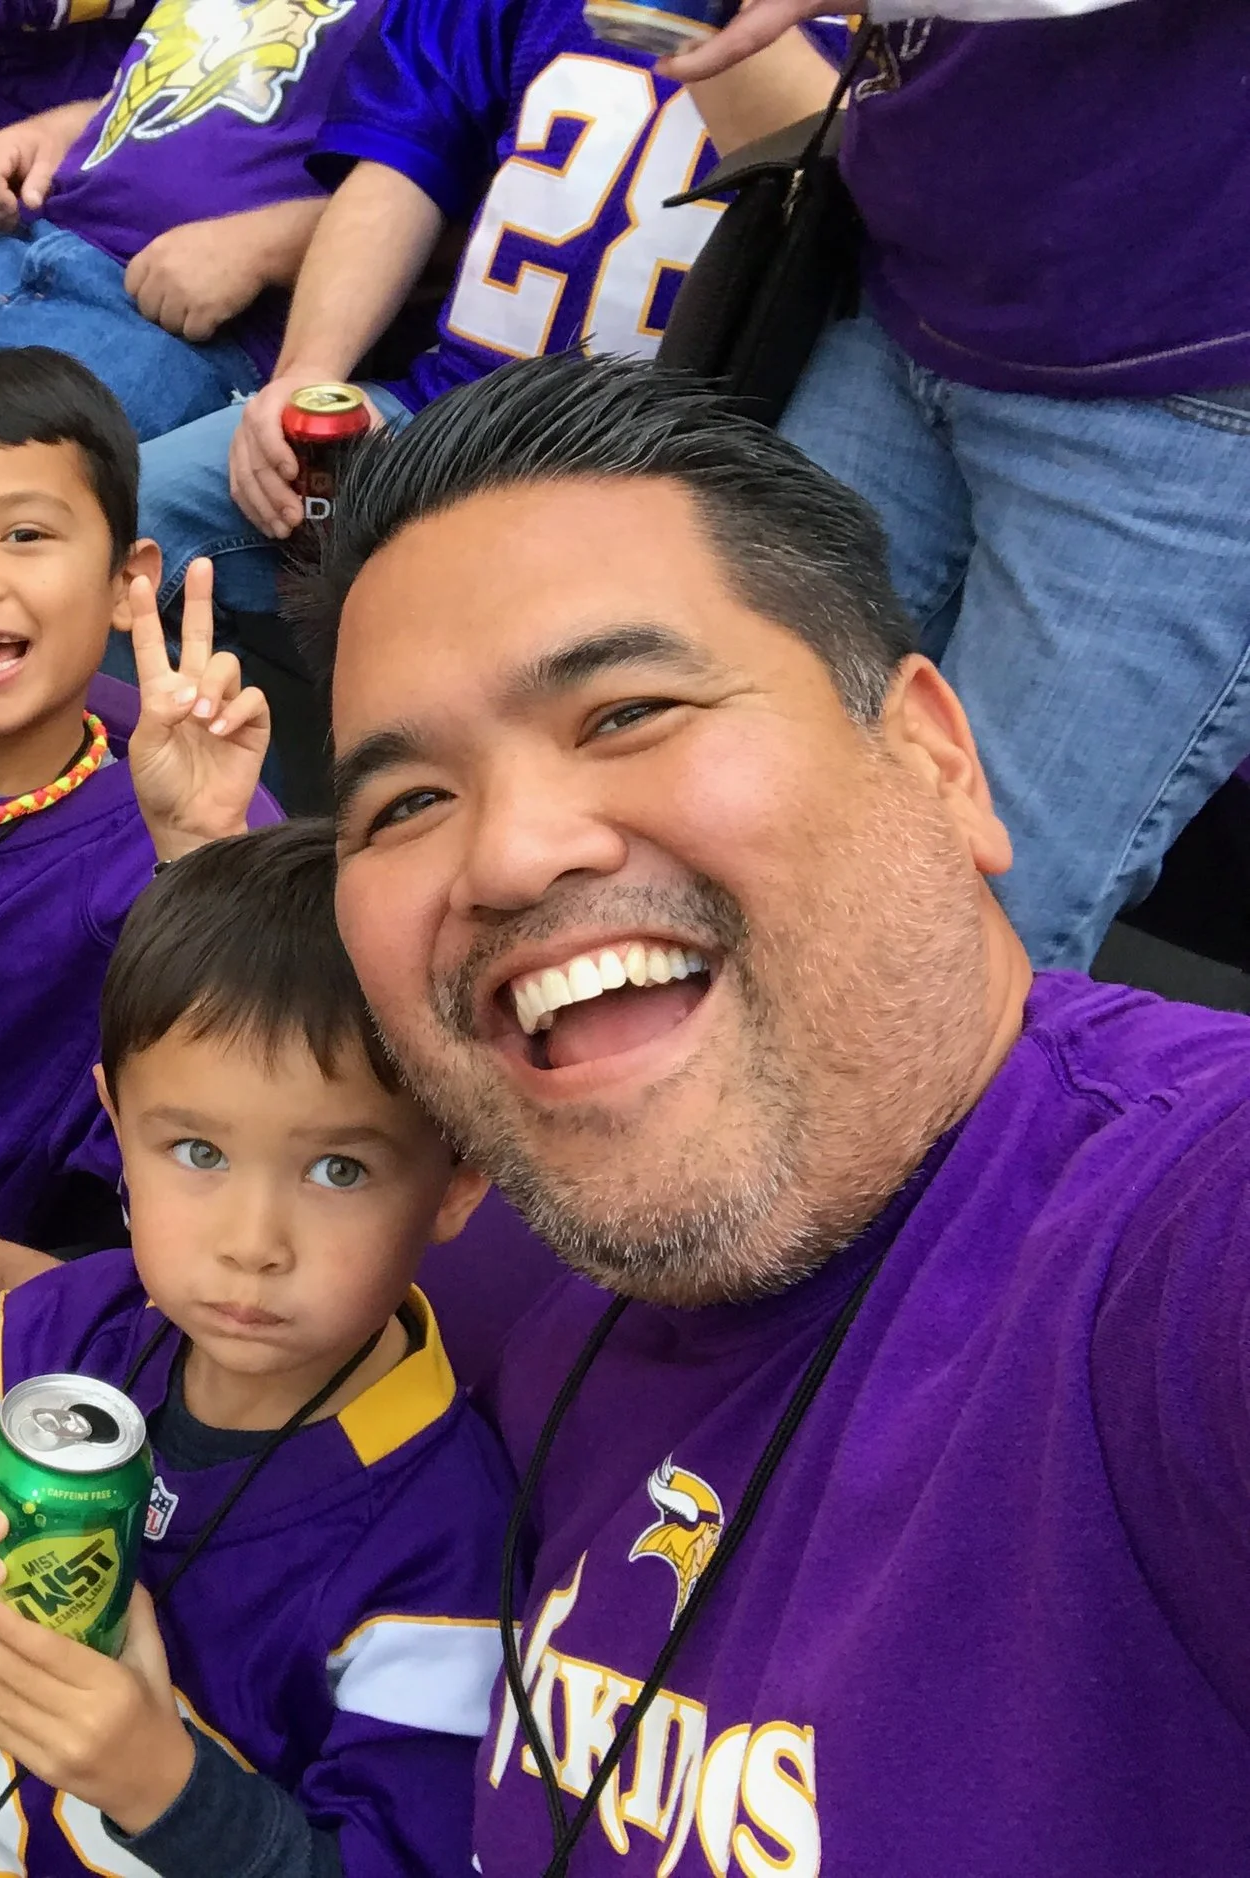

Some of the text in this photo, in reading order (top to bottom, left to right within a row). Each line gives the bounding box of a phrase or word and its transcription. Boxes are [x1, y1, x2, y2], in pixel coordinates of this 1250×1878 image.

[47, 1488, 111, 1500] CAFFEINE FREE
[21, 1551, 60, 1577] MIST
[47, 1600, 87, 1630] LEMON
